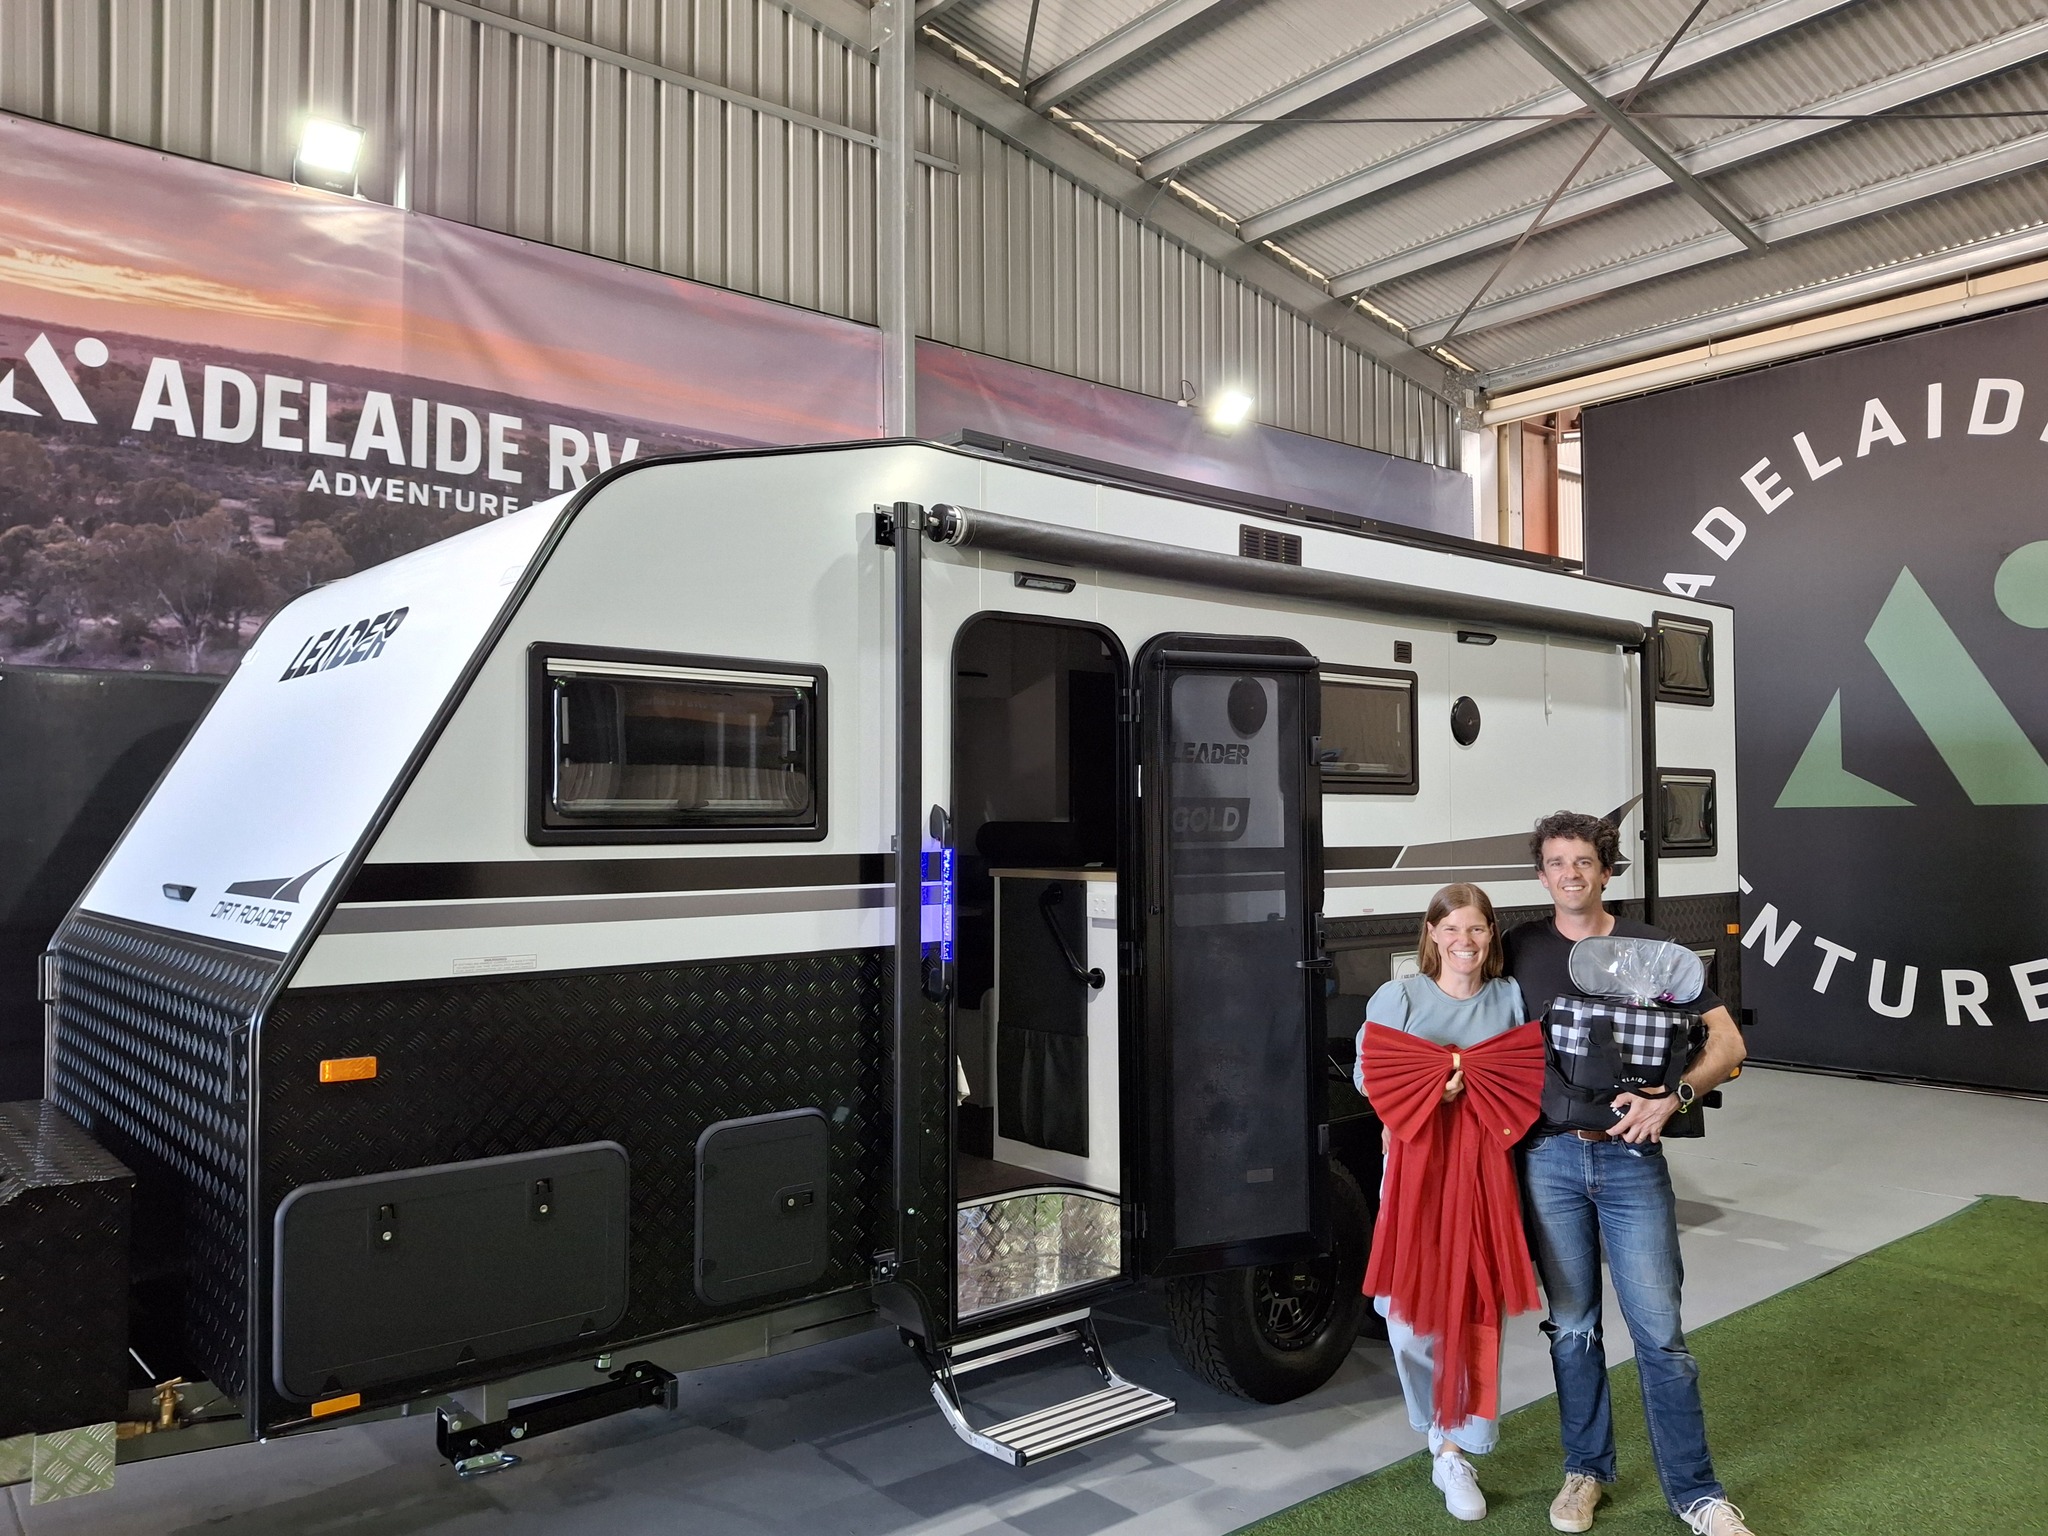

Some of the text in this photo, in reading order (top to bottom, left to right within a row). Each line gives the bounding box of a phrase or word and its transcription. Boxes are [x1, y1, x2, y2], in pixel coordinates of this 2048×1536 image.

[131, 356, 640, 491] ADELAIDE RV
[307, 468, 519, 518] ADVENTURE
[1662, 378, 2048, 598] ADELAID
[278, 606, 410, 682] LEADER
[1169, 742, 1250, 765] LEADER
[1172, 806, 1241, 833] GOLD
[210, 900, 293, 931] DIRT ROADER
